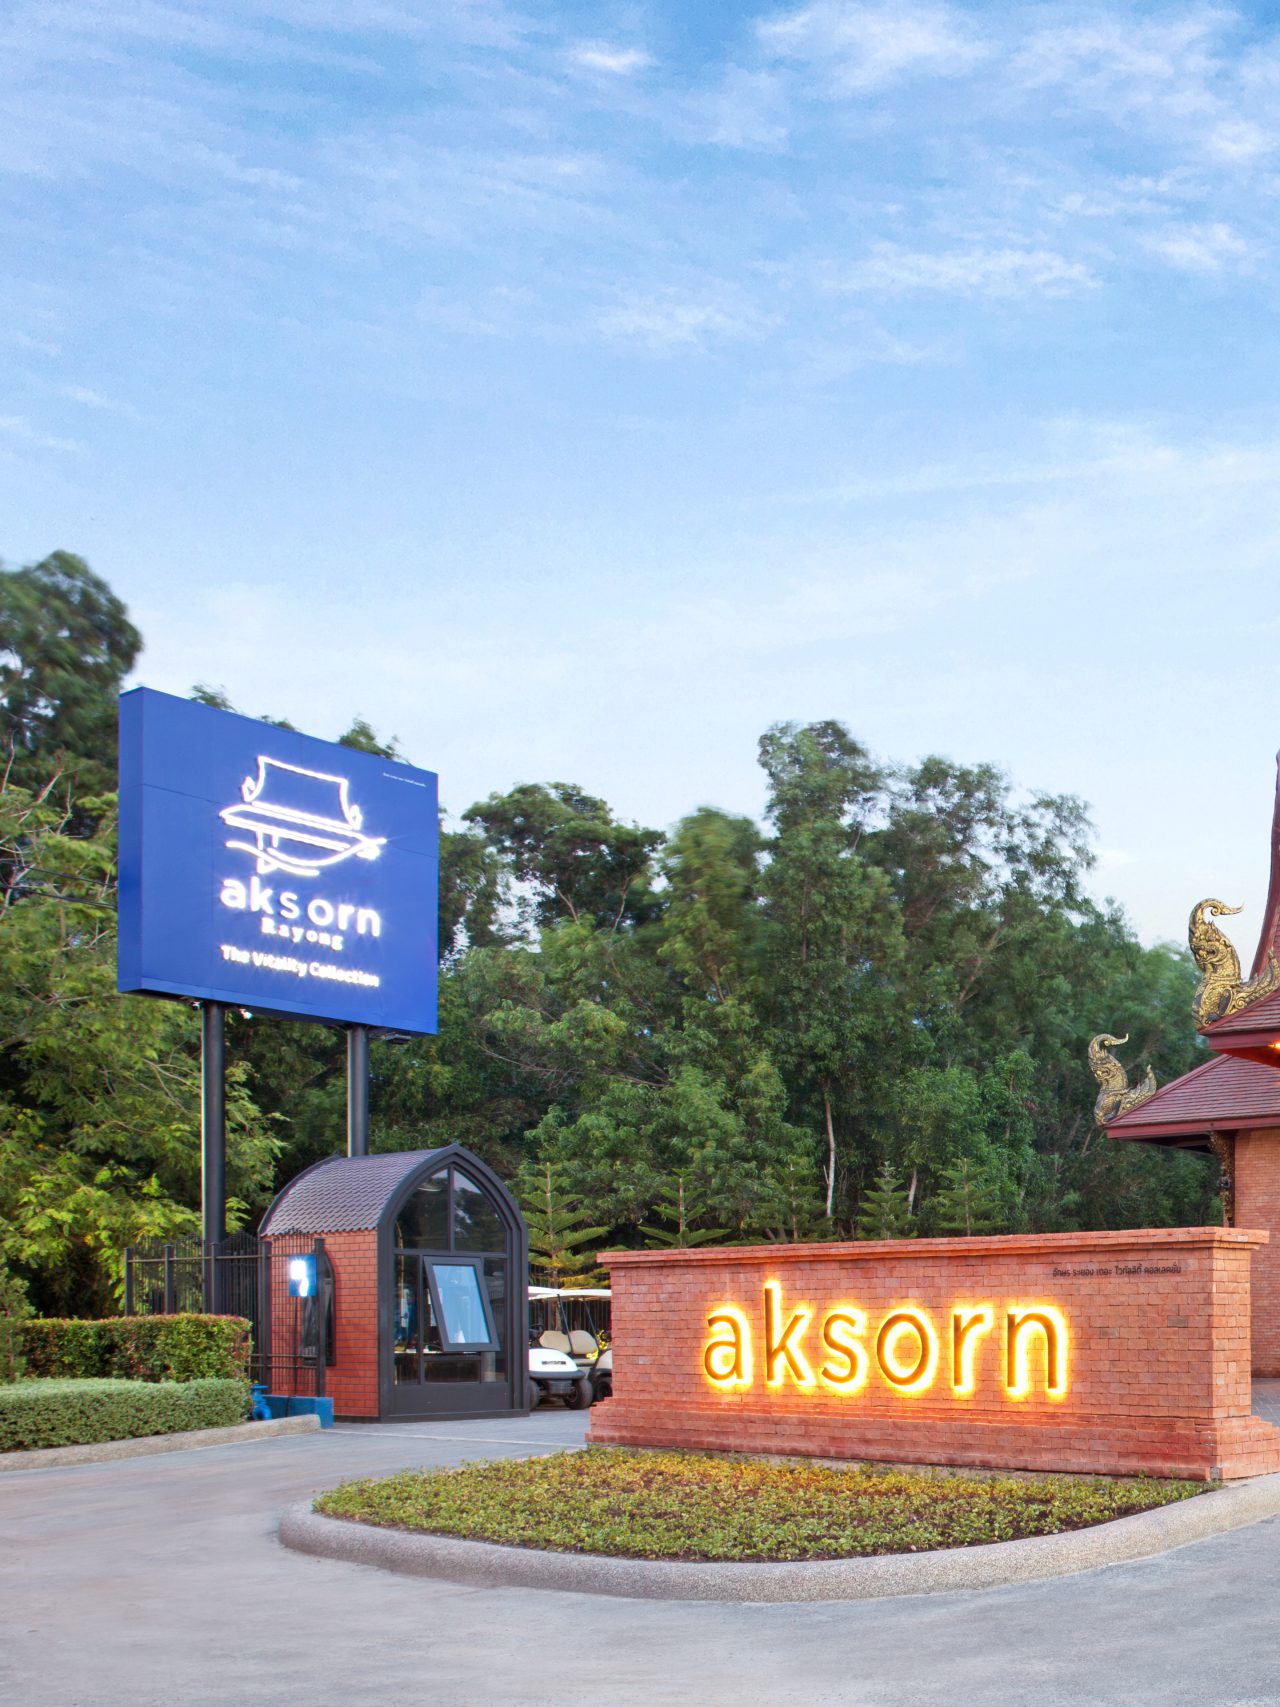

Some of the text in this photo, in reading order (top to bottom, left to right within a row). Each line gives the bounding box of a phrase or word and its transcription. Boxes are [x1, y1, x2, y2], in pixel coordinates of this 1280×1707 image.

[220, 876, 381, 937] aksorn
[260, 916, 344, 951] Rayong
[220, 944, 380, 988] The Vitality Collection
[703, 1282, 1064, 1393] aksorn
